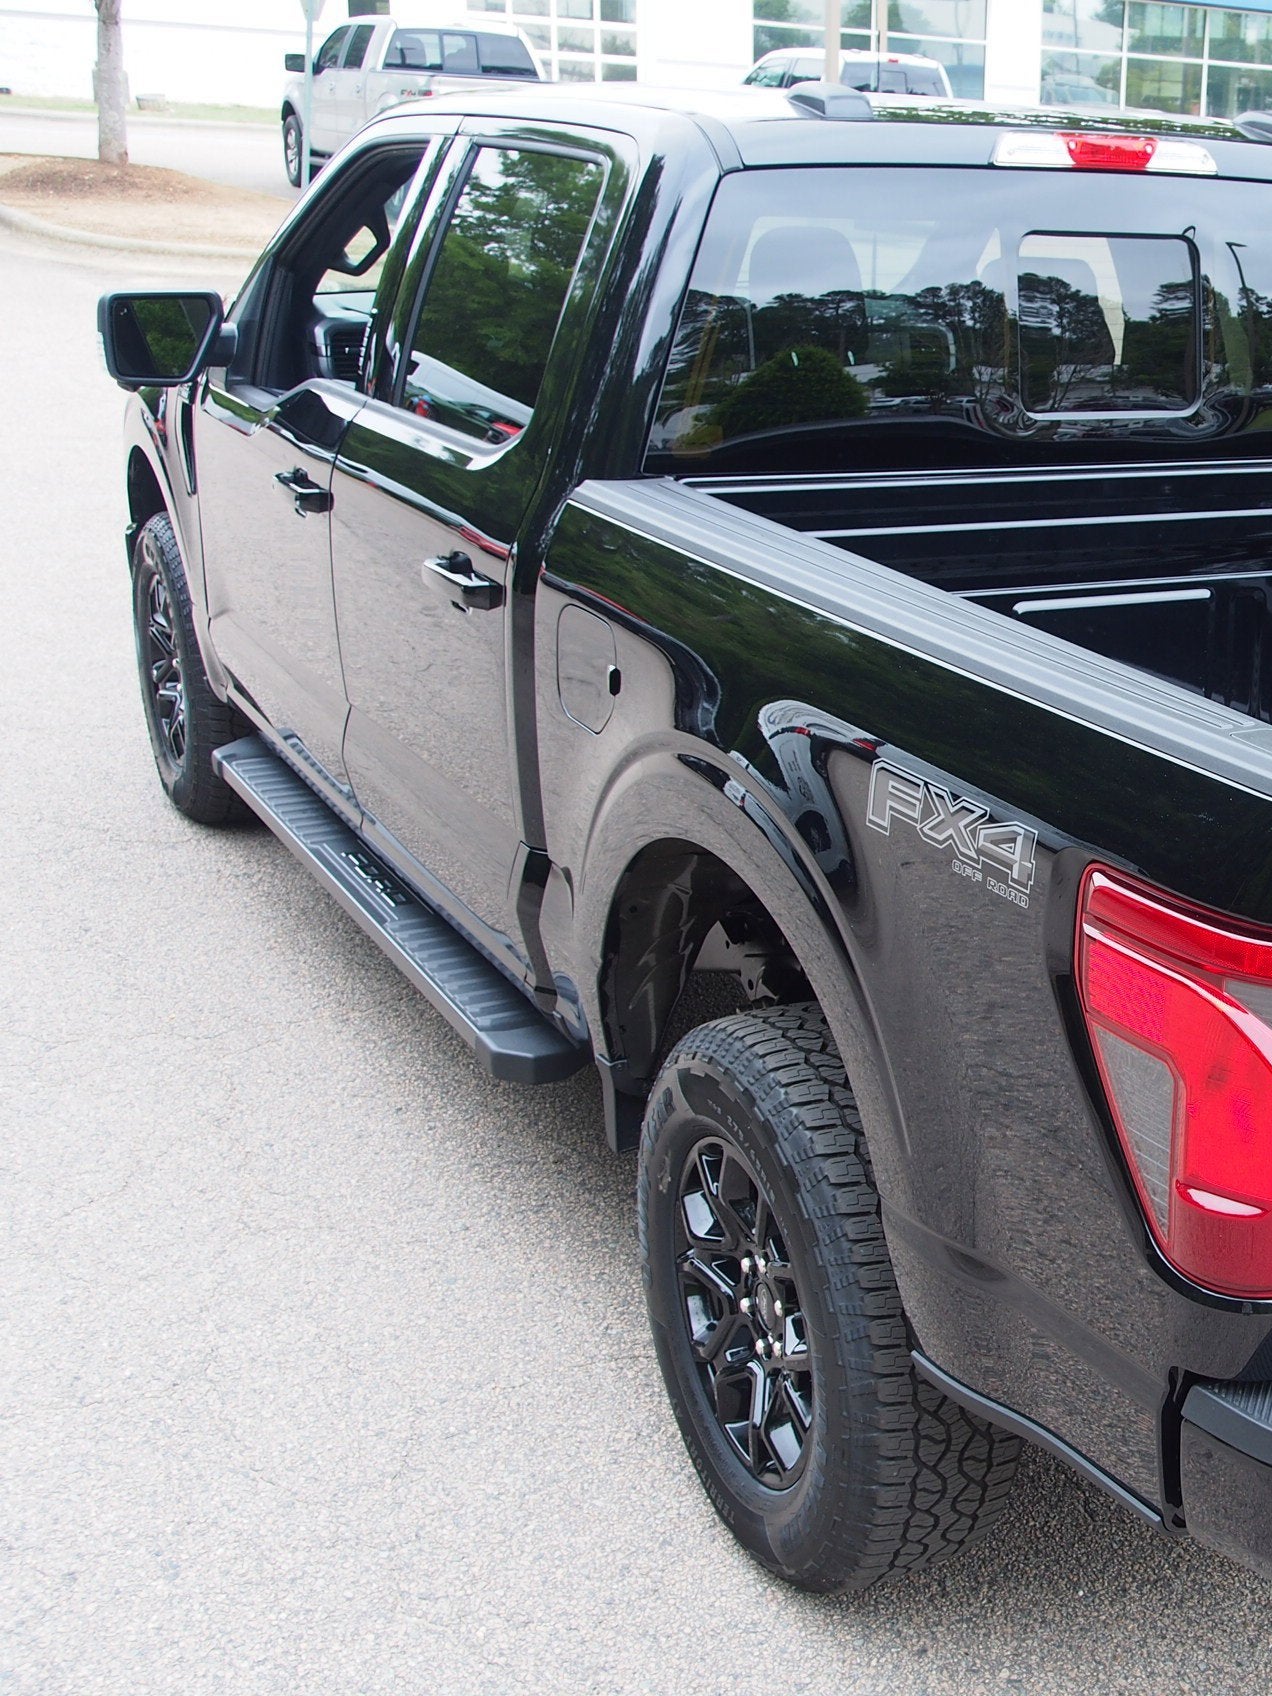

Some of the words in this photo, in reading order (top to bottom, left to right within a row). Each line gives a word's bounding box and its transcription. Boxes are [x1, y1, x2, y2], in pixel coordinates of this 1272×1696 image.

[866, 757, 1039, 894] FX4
[951, 859, 983, 883] OFF
[986, 876, 1030, 910] ROAD
[685, 1433, 736, 1525] TERRITORY
